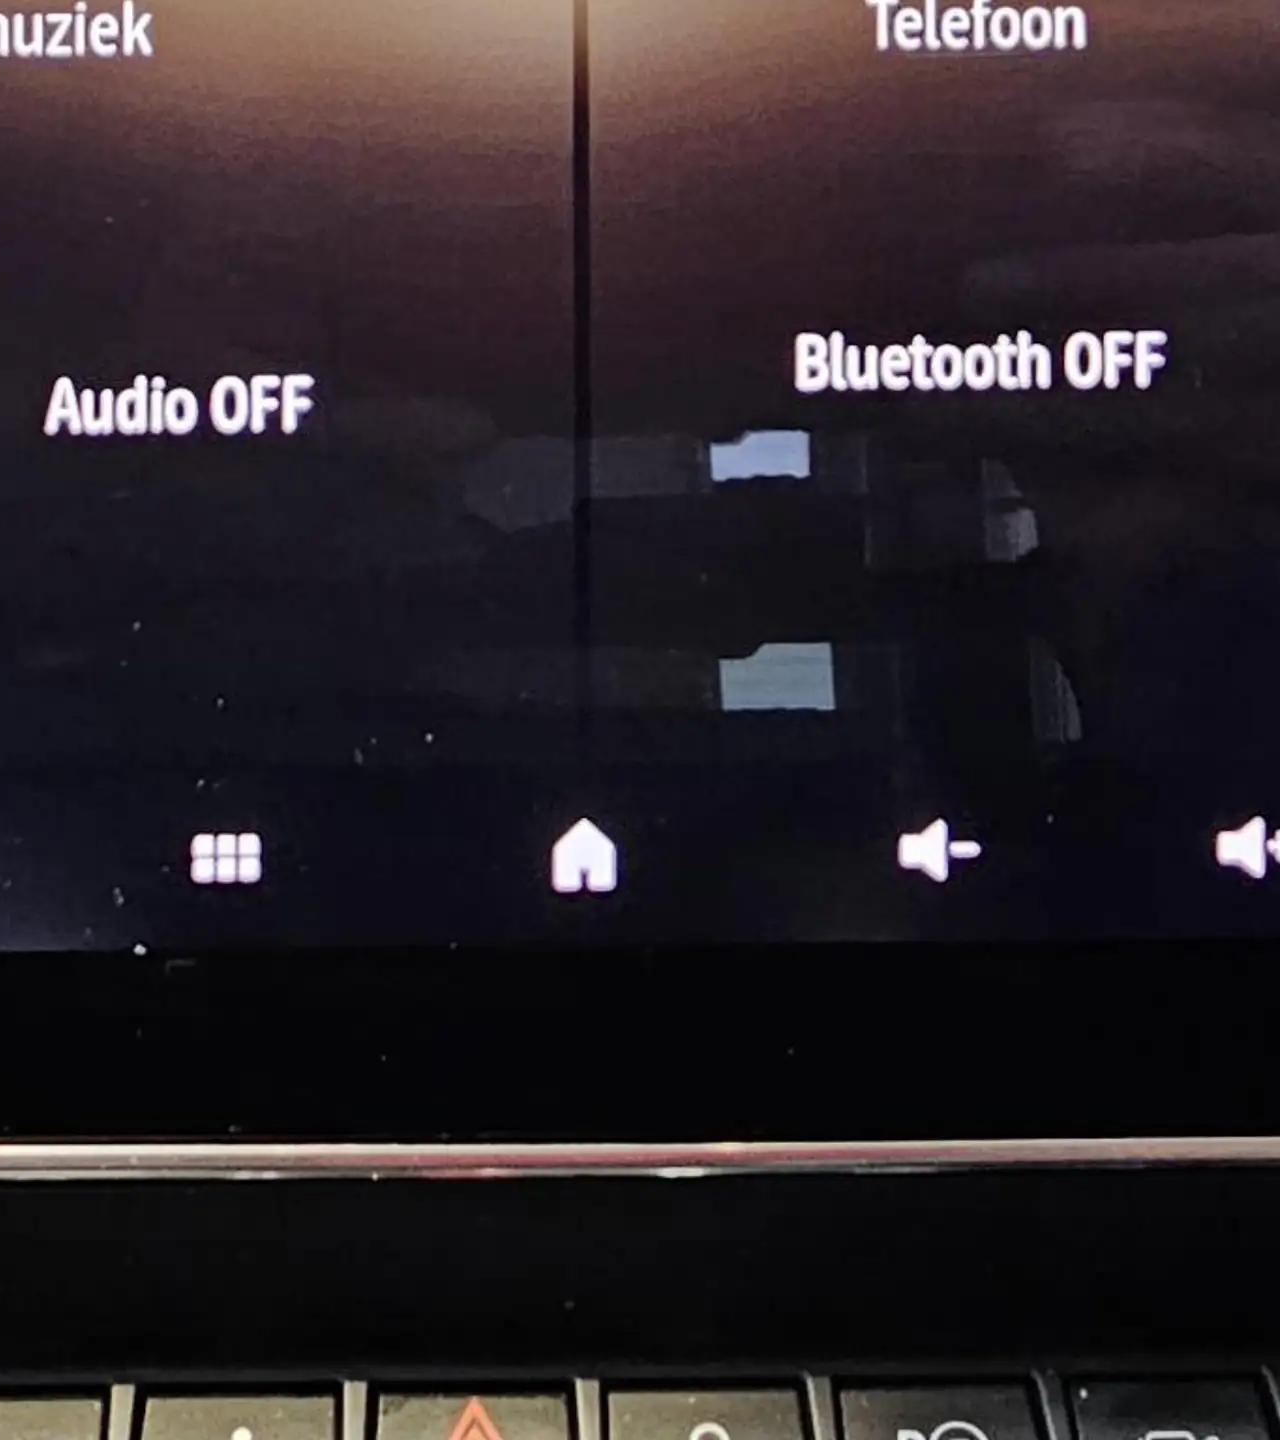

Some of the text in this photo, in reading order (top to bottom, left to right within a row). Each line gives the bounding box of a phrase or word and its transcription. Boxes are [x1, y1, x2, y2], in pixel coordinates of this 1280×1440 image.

[793, 330, 1170, 392] Bluetooth OFF
[43, 373, 317, 436] Audio OFF
